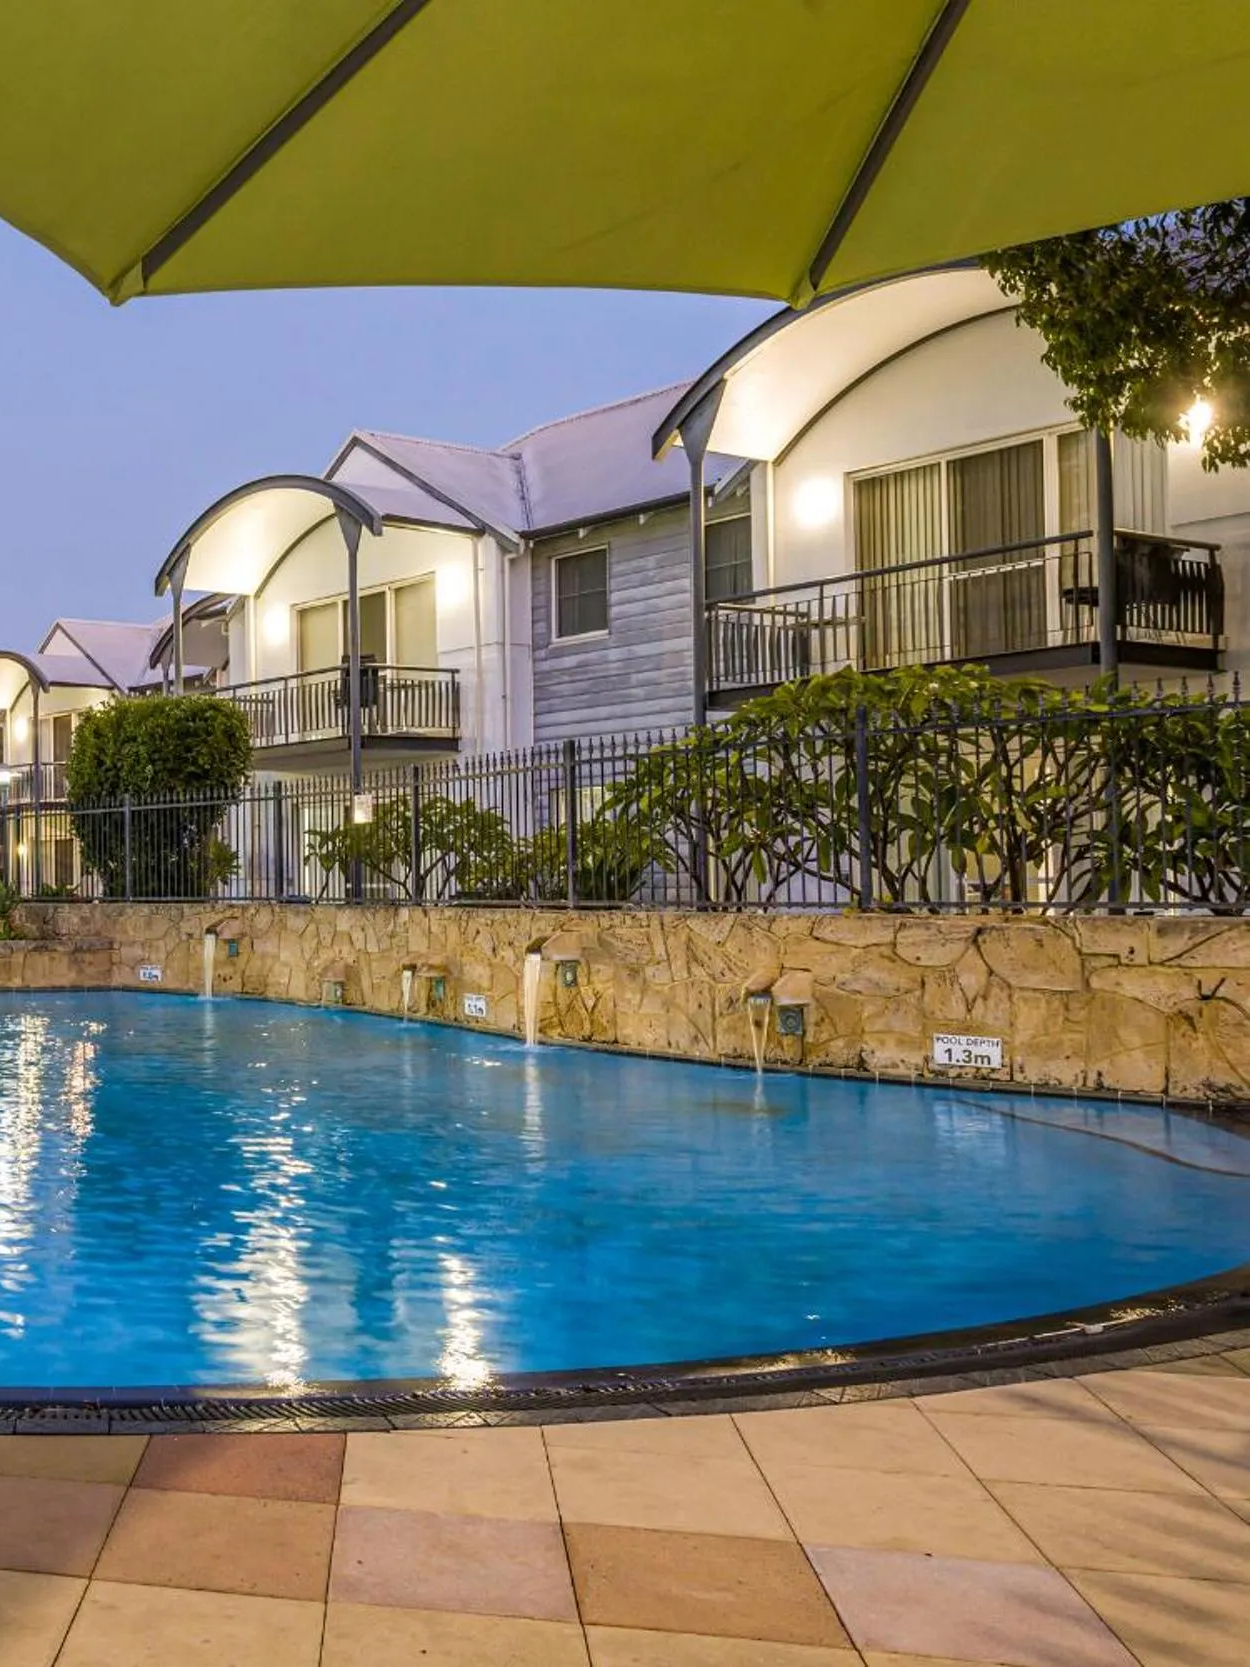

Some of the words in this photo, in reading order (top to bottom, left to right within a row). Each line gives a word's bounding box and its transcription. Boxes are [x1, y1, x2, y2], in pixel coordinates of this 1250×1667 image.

[935, 1036, 962, 1046] POOL
[966, 1038, 999, 1048] DEPTH
[944, 1048, 991, 1065] 1.3m
